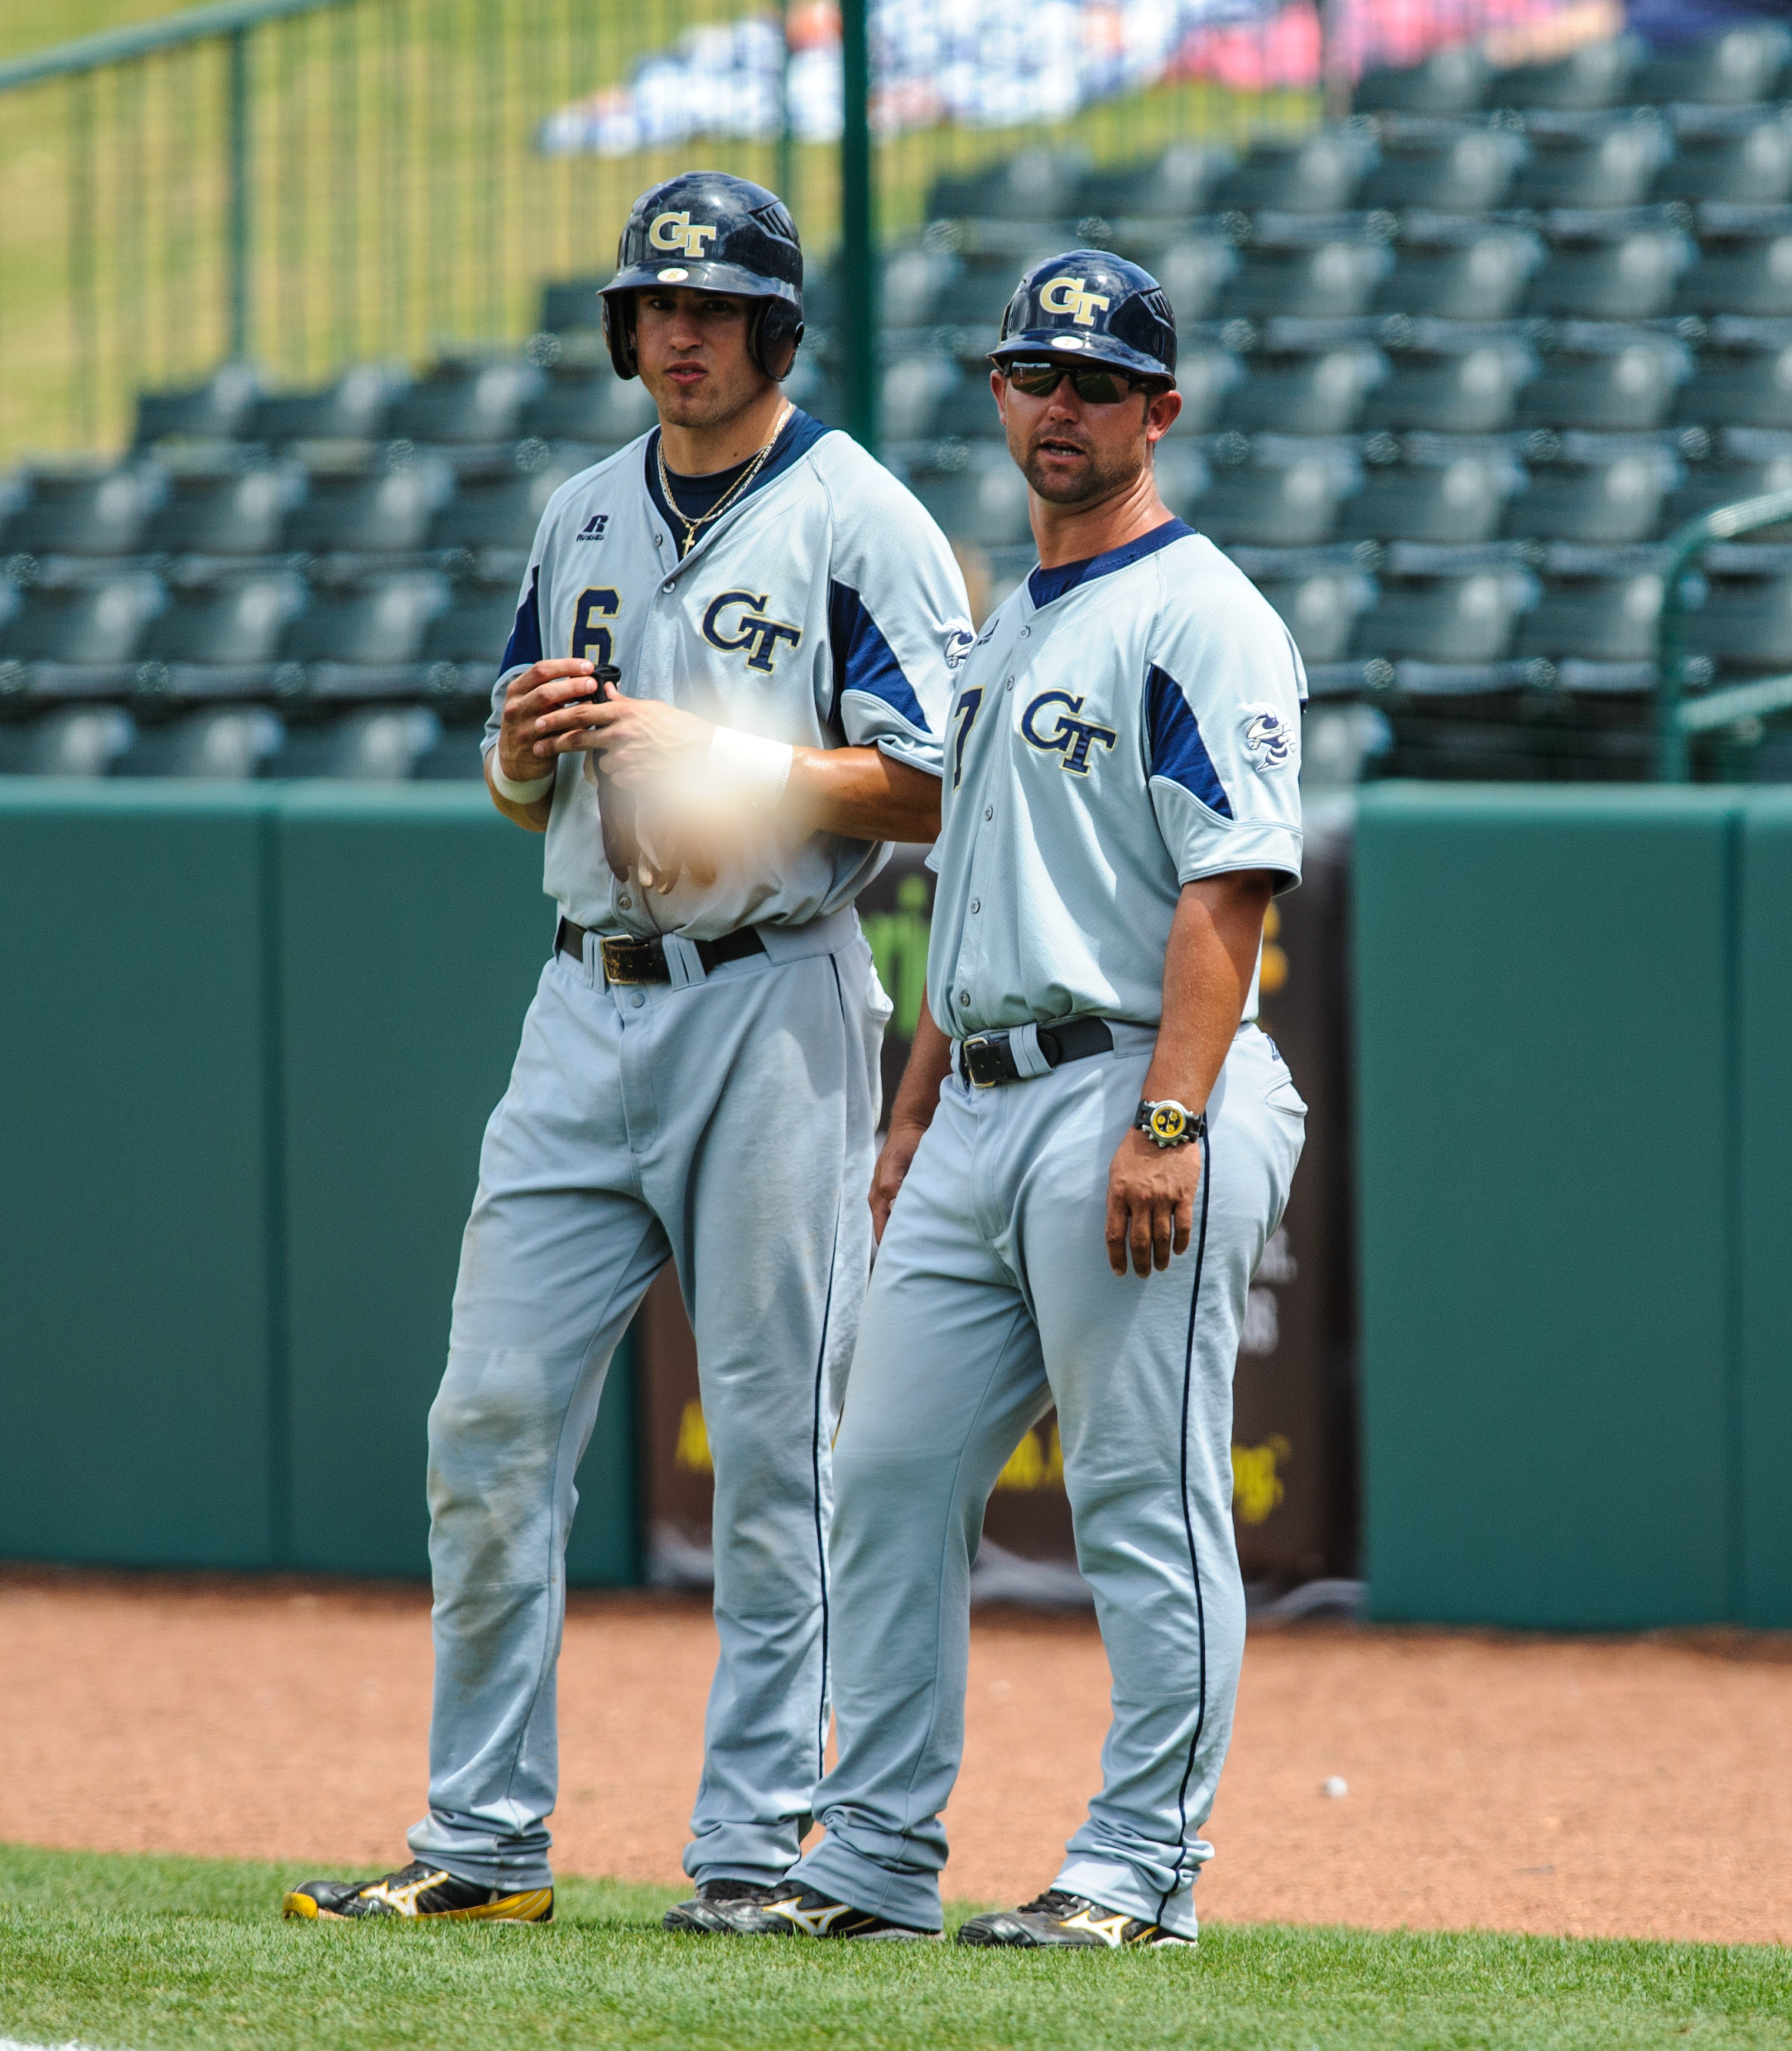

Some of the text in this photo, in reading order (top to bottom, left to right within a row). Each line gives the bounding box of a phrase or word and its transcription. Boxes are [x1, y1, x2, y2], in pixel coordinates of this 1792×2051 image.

[649, 211, 716, 258] GT
[1040, 277, 1110, 326] GT
[570, 585, 622, 666] 6
[701, 590, 803, 675] GT
[951, 685, 986, 794] 7
[1019, 688, 1117, 777] GT
